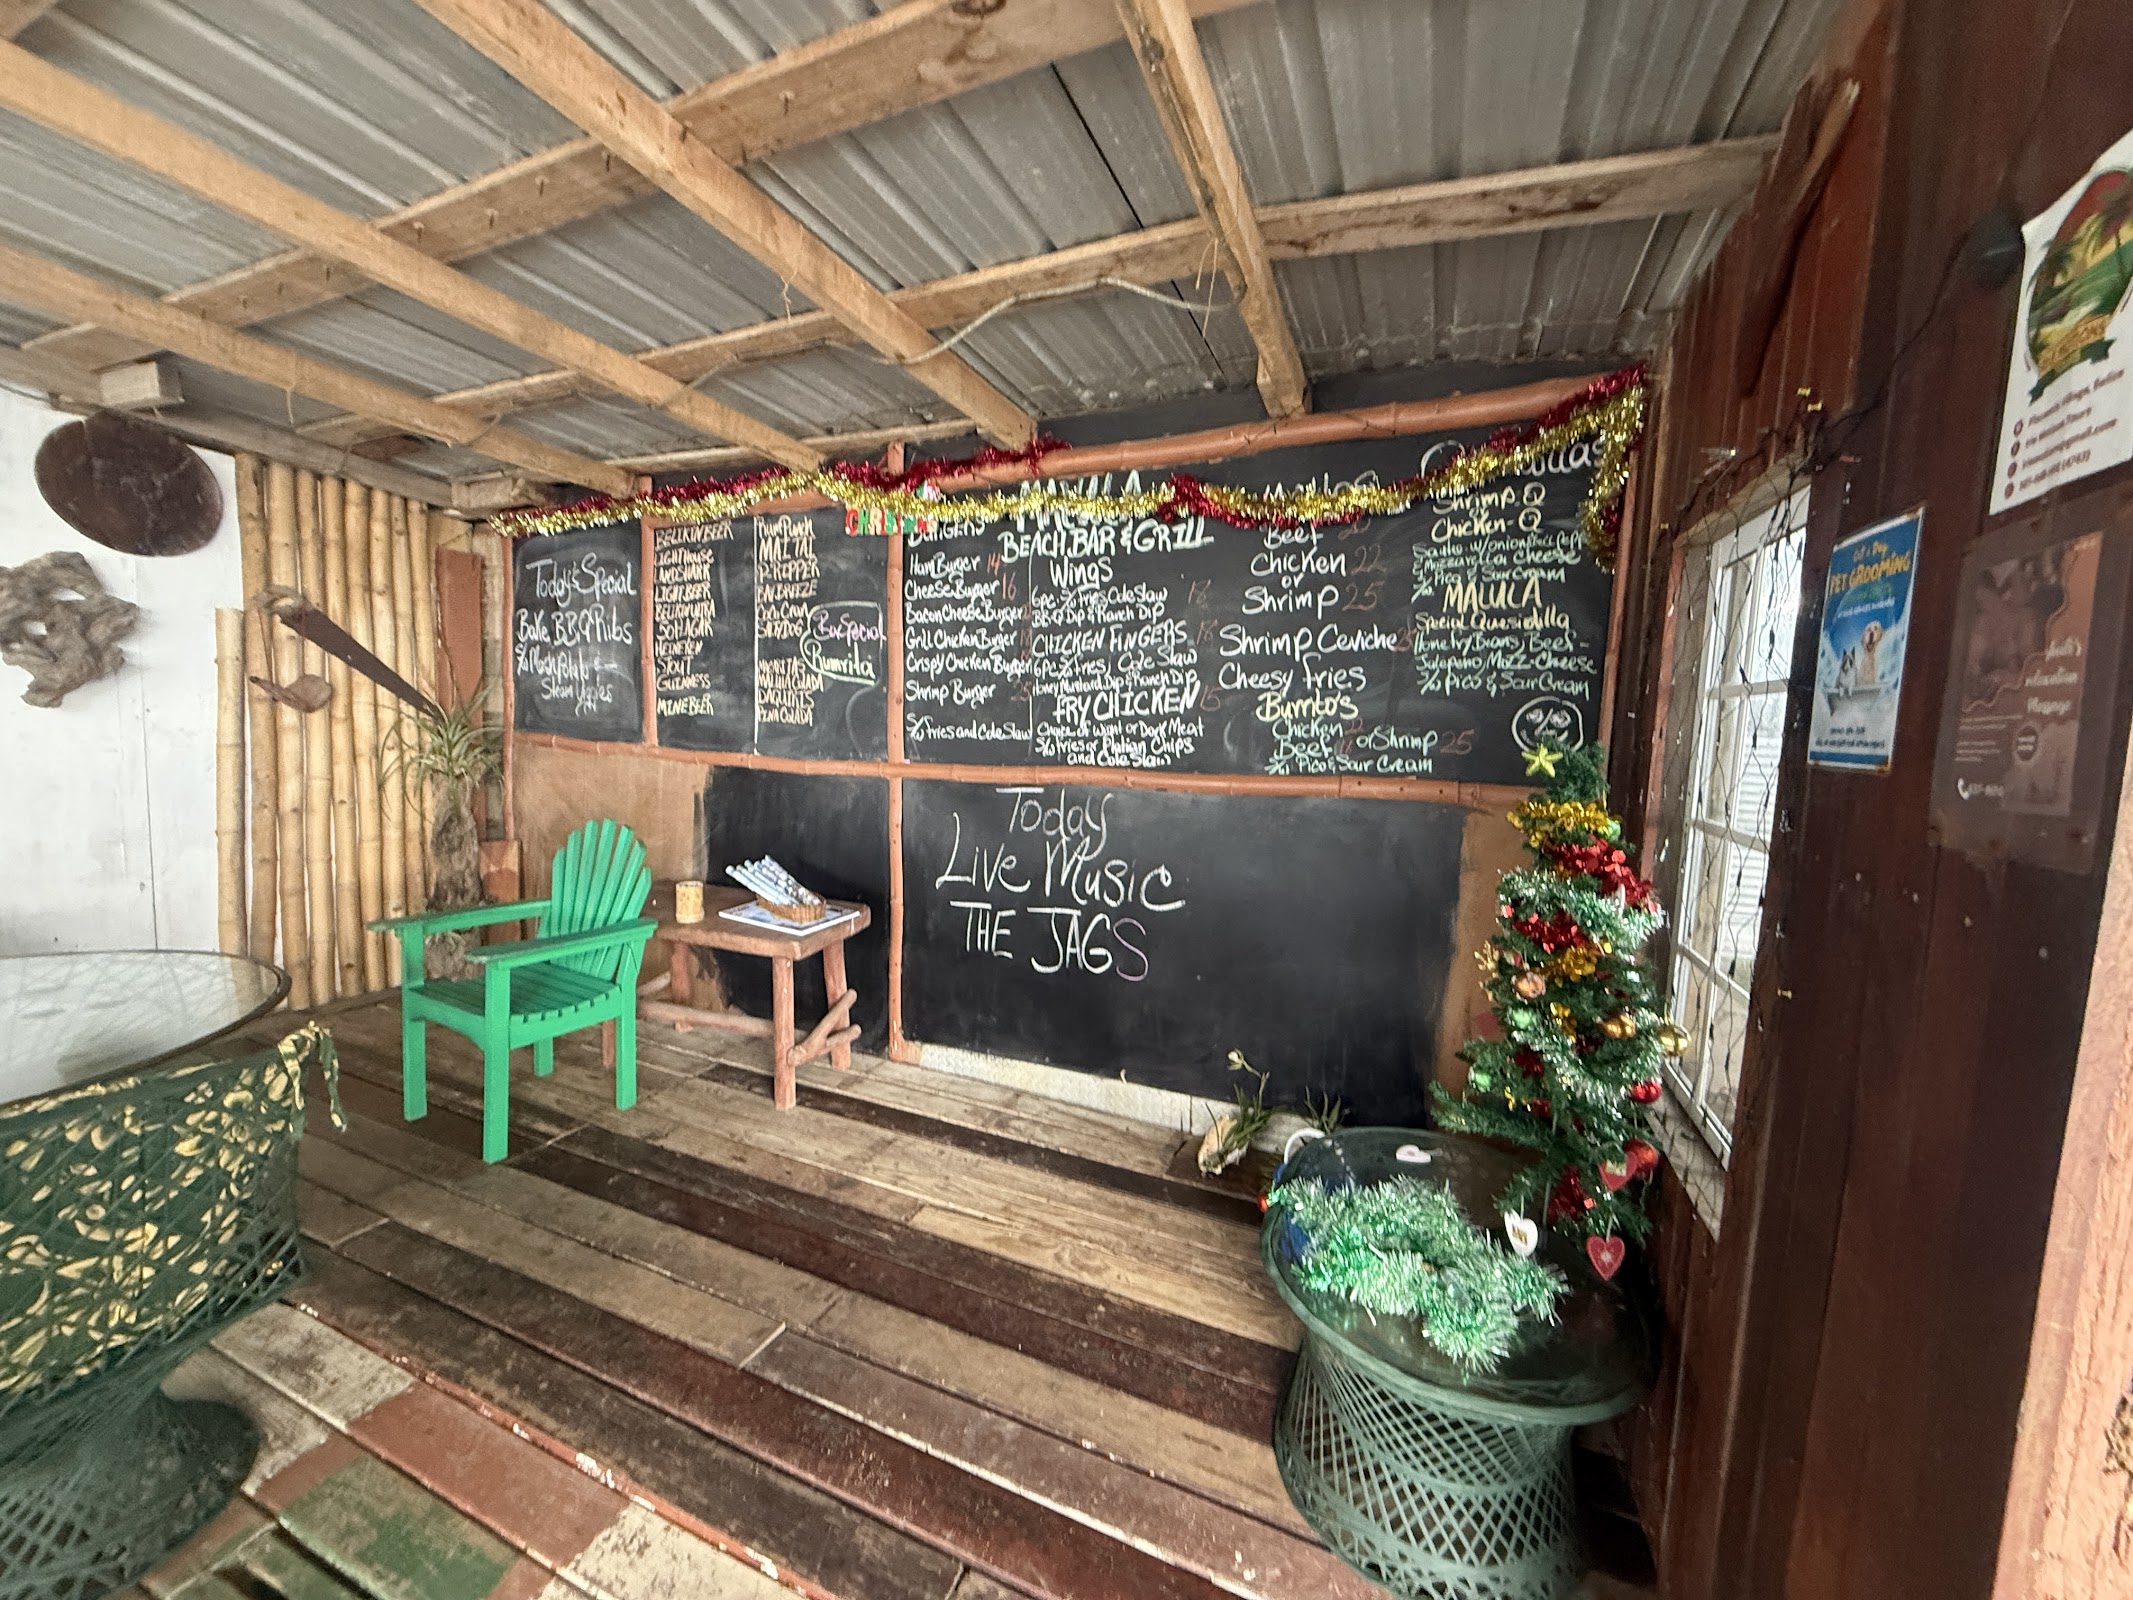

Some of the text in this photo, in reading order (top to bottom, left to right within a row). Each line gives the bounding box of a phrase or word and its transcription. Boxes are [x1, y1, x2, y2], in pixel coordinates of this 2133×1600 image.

[998, 517, 1214, 563] BEACH BAR & GRILL
[1050, 556, 1114, 590] Wings
[1251, 545, 1346, 577] Chicken
[1002, 571, 1017, 600] 16
[1134, 582, 1168, 603] Slaw
[1281, 572, 1304, 589] or
[1138, 602, 1165, 625] Dip
[1242, 584, 1339, 620] Shrimp
[1032, 626, 1106, 658] CHICKEN
[1156, 644, 1198, 669] Slaw
[1219, 623, 1313, 662] Shrimp
[1317, 623, 1398, 654] Ceviche
[949, 677, 997, 710] Burger
[1218, 661, 1294, 697] Cheesy
[1092, 680, 1201, 720] CHICKEN
[1126, 722, 1139, 736] or
[1168, 715, 1205, 738] Meat
[1067, 750, 1096, 766] and
[1150, 735, 1195, 759] Chips
[1376, 753, 1433, 774] Cream
[996, 787, 1114, 862] Today
[936, 812, 1186, 912] Live Music
[950, 900, 1149, 982] THE JAGS
